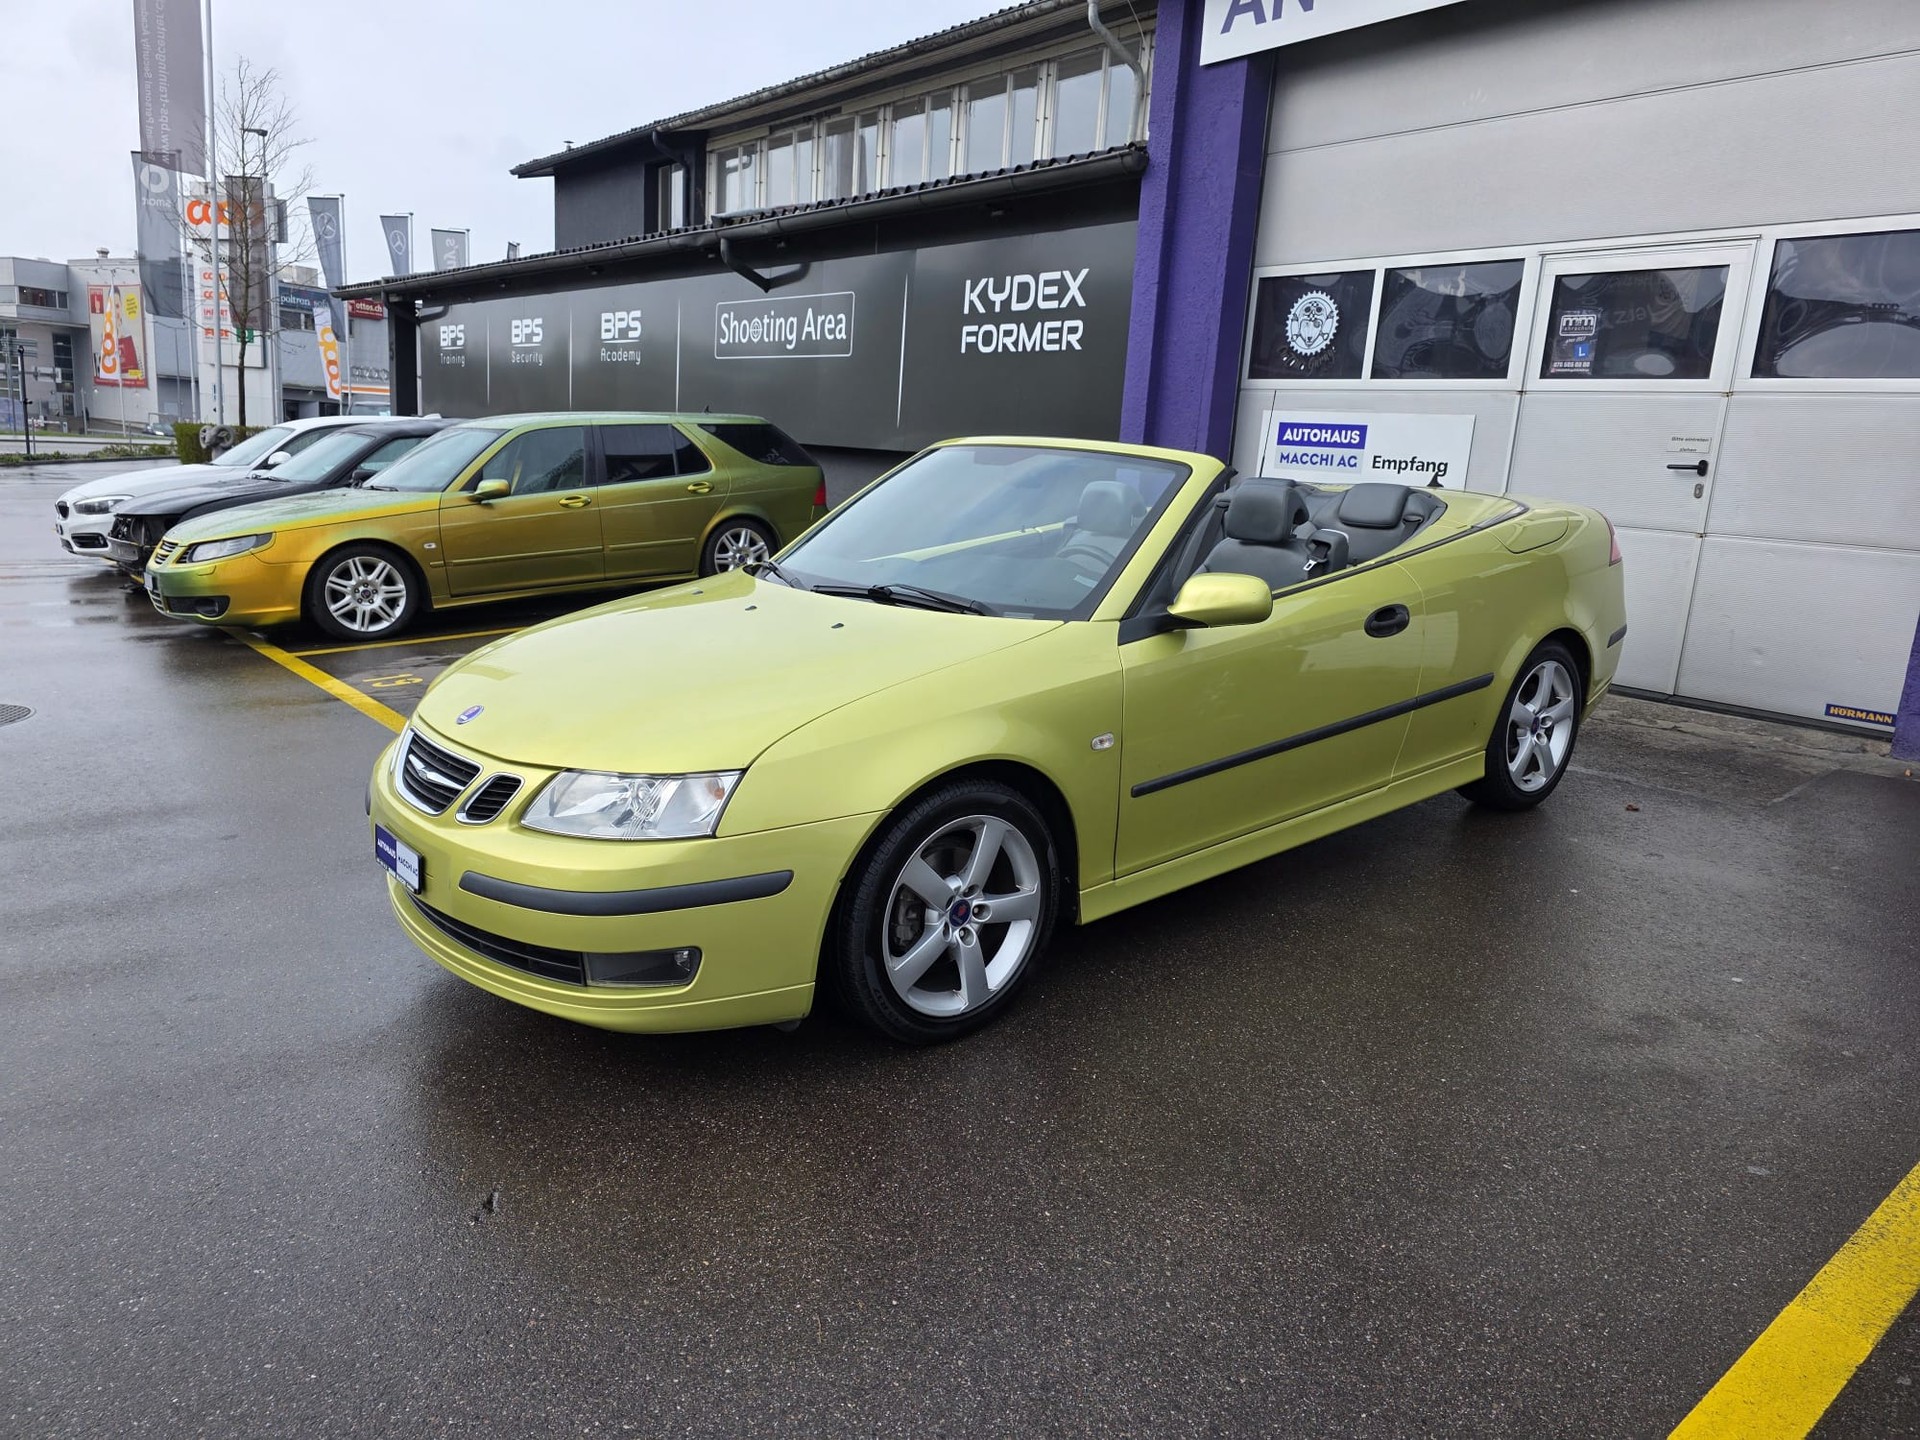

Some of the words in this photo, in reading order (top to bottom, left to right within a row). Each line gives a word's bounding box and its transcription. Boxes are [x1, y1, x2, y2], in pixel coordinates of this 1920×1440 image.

[963, 268, 1090, 315] KYDEX
[355, 302, 383, 314] ottos.ch
[439, 324, 465, 347] BPS
[511, 318, 543, 344] BPS
[600, 310, 642, 340] BPS
[719, 309, 798, 350] Shooting
[802, 307, 847, 341] Area
[960, 320, 1084, 354] FORMER
[440, 353, 465, 367] Training
[511, 350, 543, 366] Security
[600, 348, 641, 366] Academy
[1578, 346, 1586, 357] L
[1282, 428, 1361, 445] AUTOHAUS
[1279, 451, 1334, 467] MACCHI
[1336, 454, 1358, 468] AG
[1371, 455, 1449, 478] Empfang
[377, 837, 396, 860] AUTOHAUS
